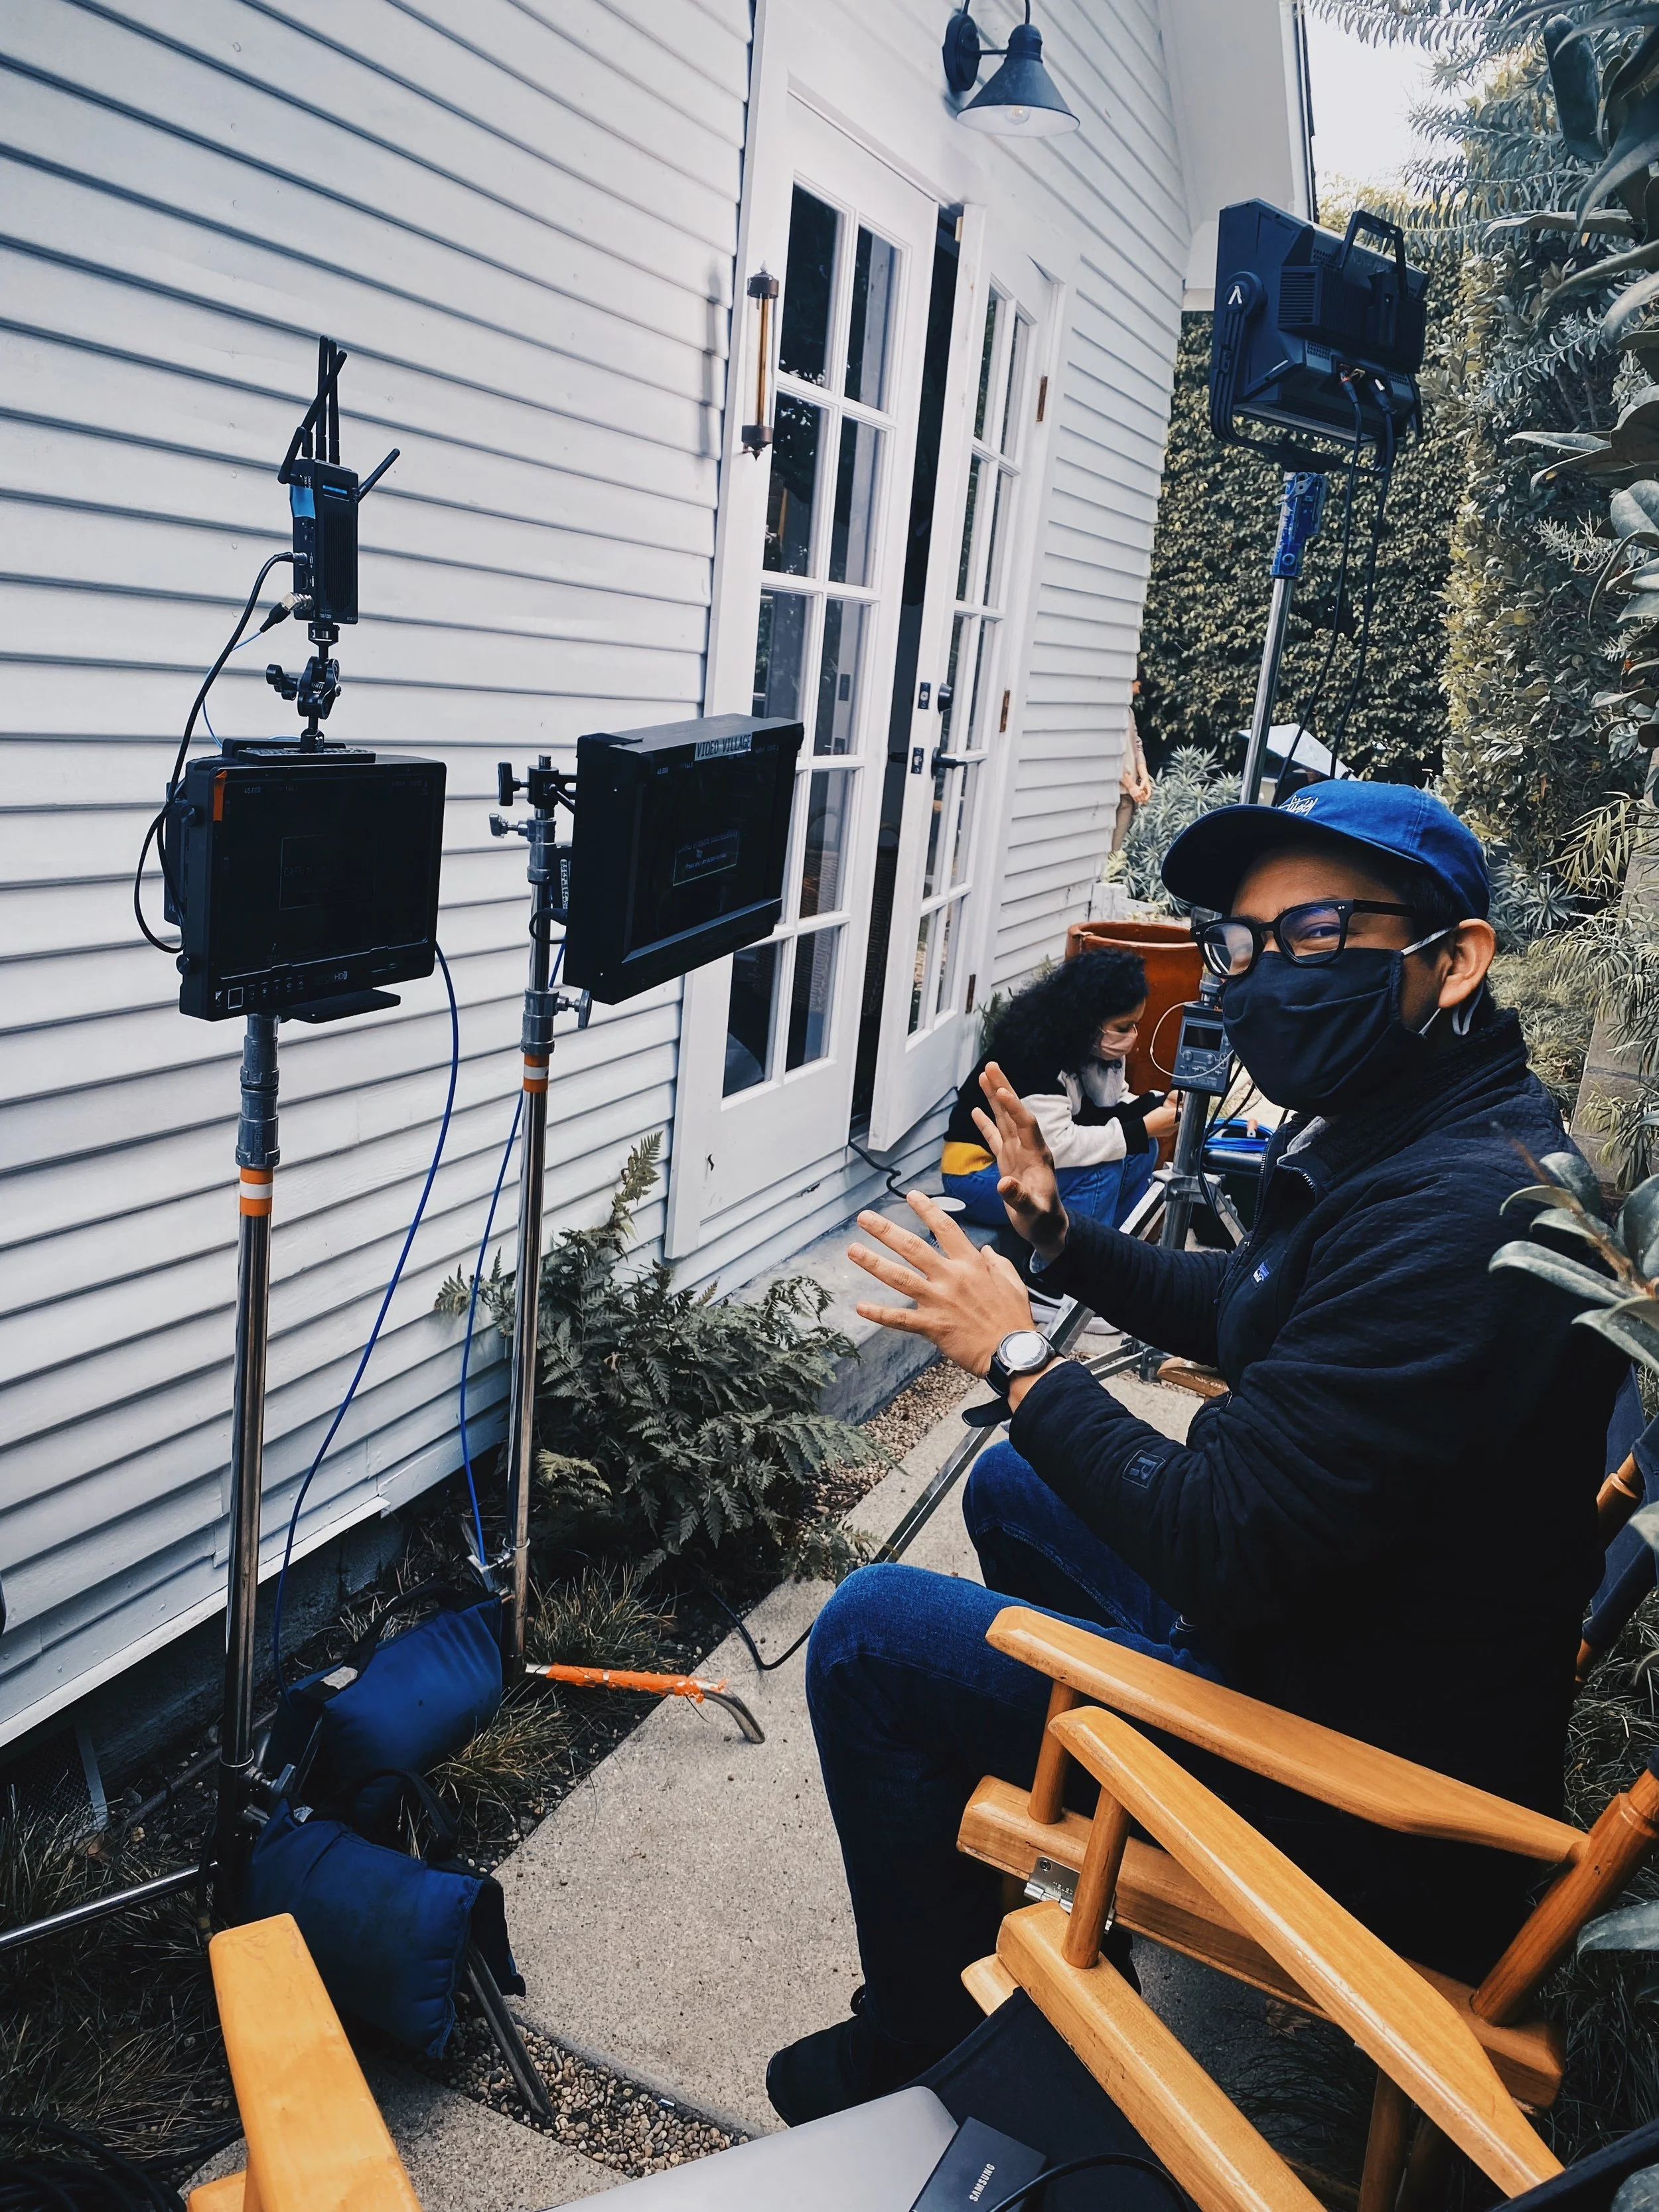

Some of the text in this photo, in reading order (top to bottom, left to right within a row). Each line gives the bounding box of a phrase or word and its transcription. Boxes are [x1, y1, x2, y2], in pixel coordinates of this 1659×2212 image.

[697, 740, 719, 757] VIDEO
[722, 734, 751, 753] VILLAGE
[969, 2163, 995, 2202] SAMSUNG
